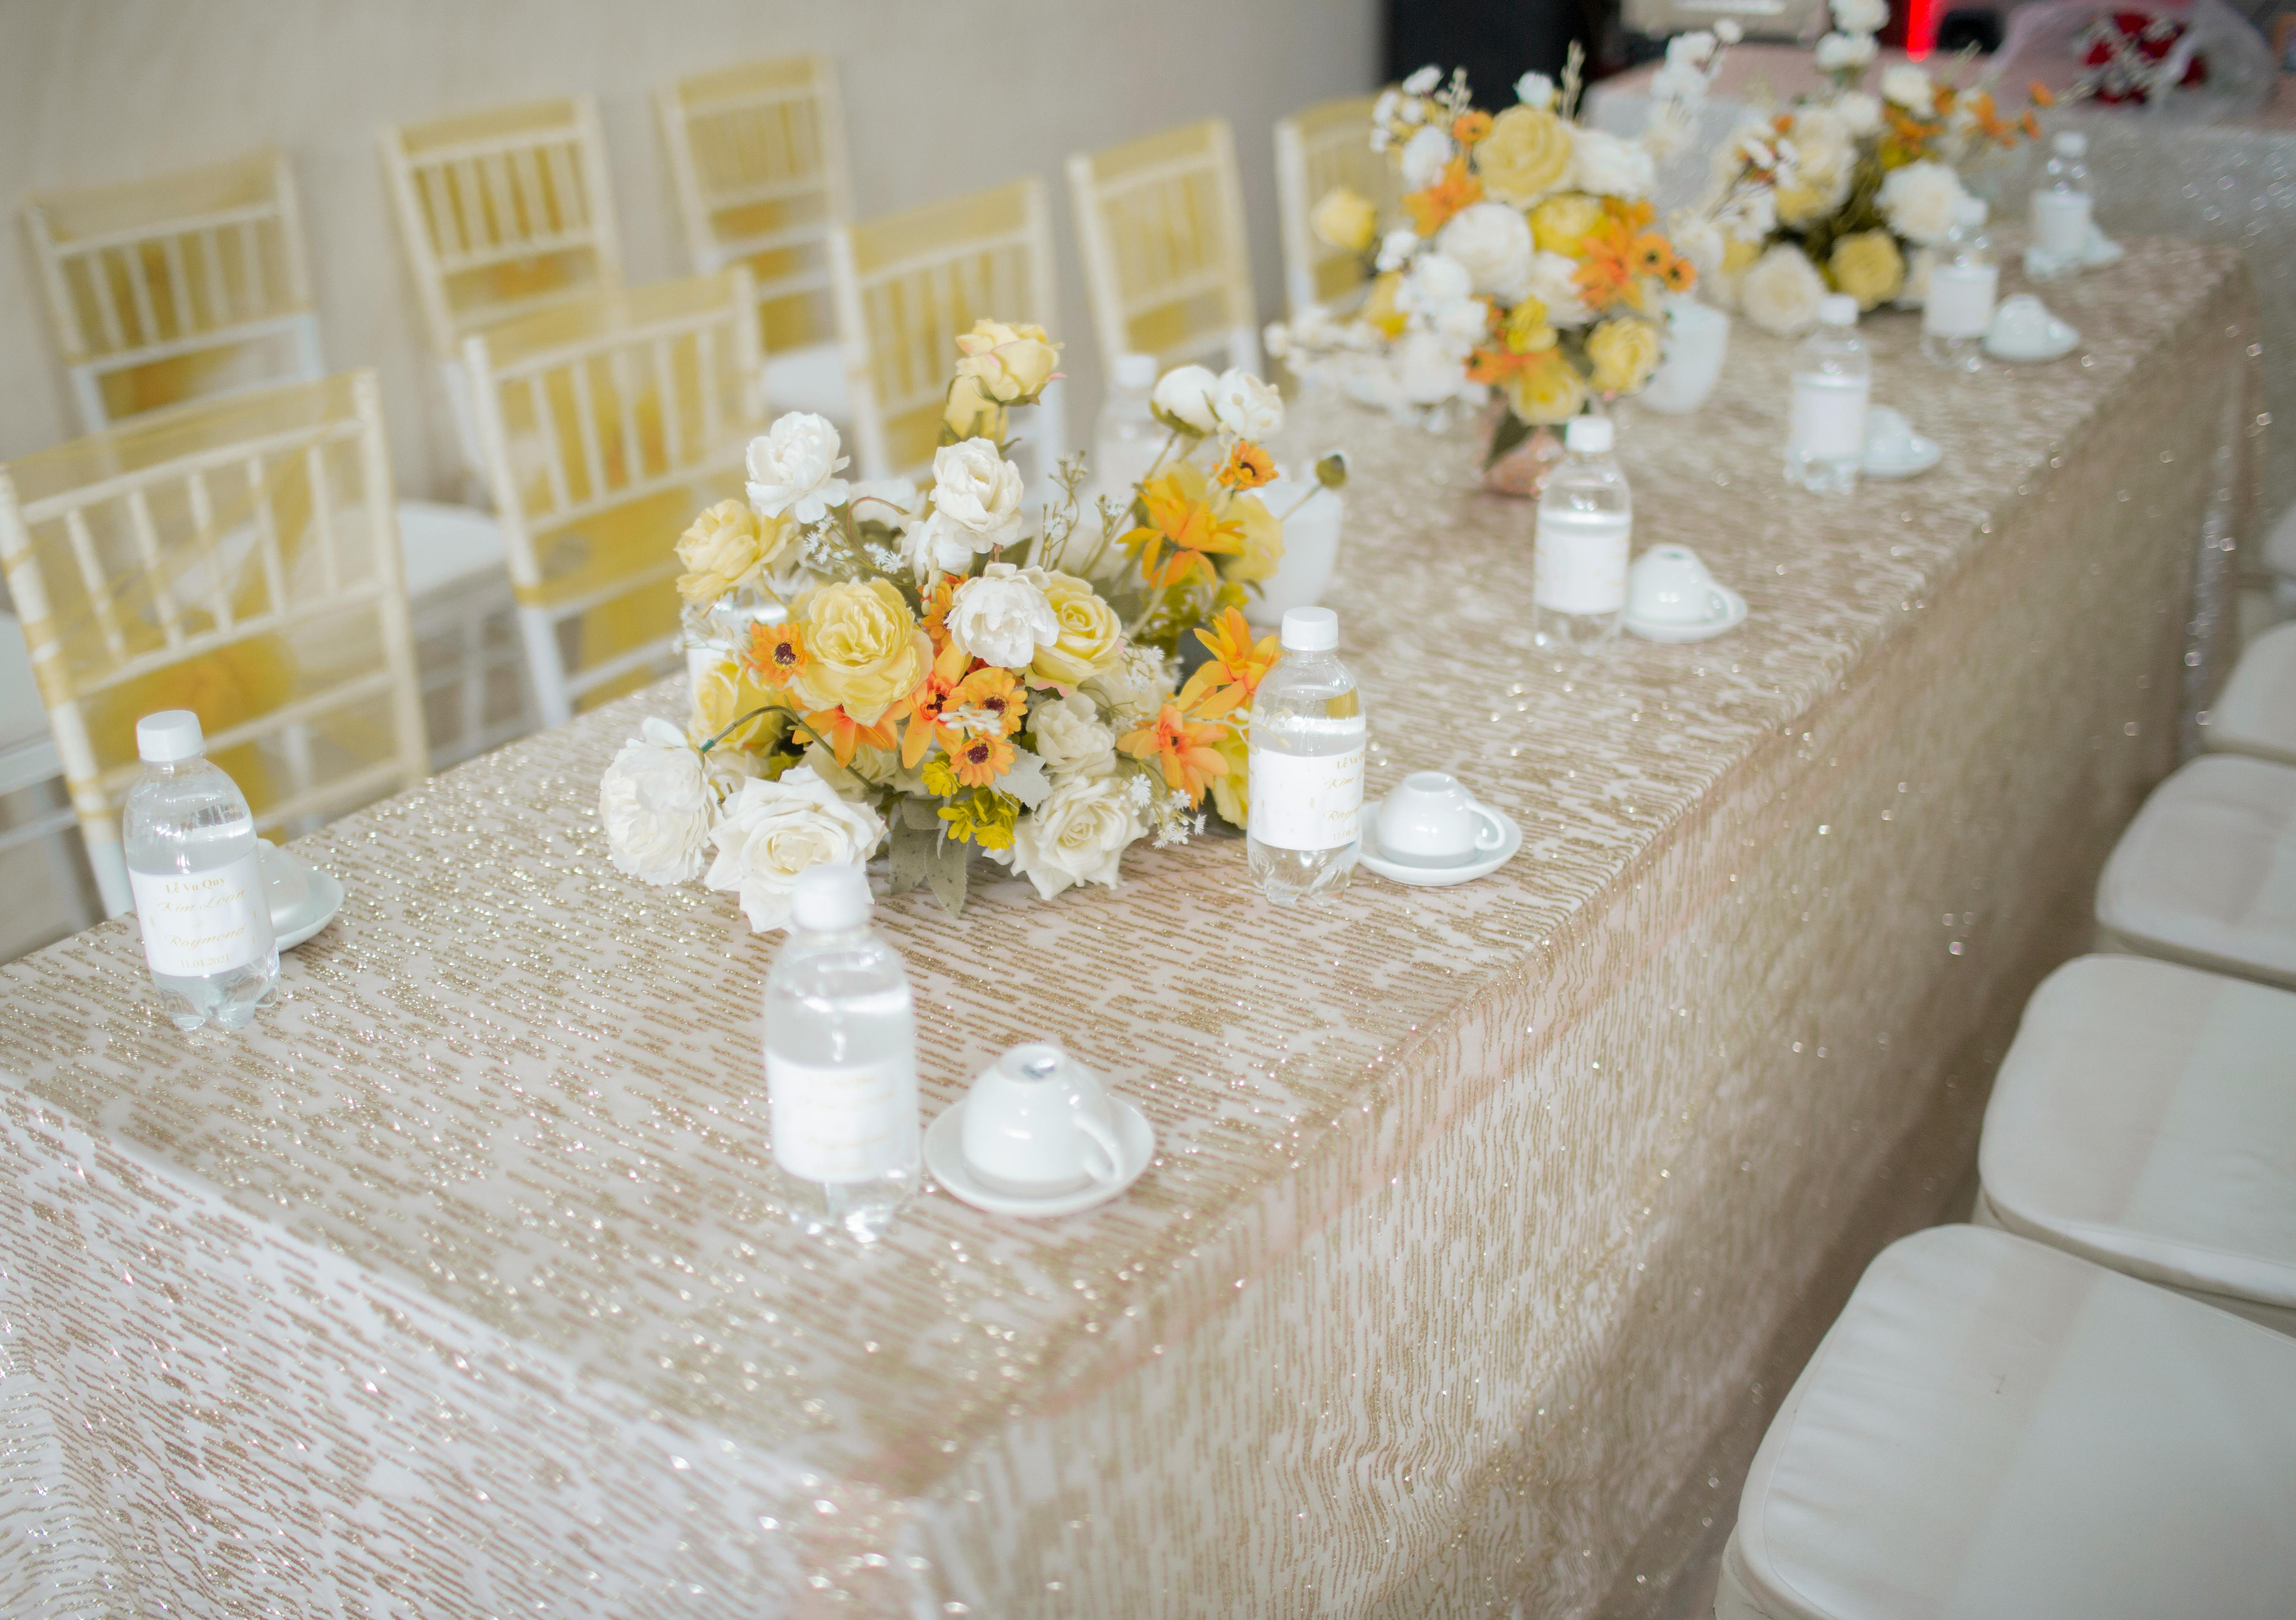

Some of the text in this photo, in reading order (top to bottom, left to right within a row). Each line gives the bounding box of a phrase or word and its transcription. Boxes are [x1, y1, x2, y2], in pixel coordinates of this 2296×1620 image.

[202, 877, 226, 889] Quy
[158, 888, 246, 913] Kim Loan
[165, 923, 248, 951] Raymond
